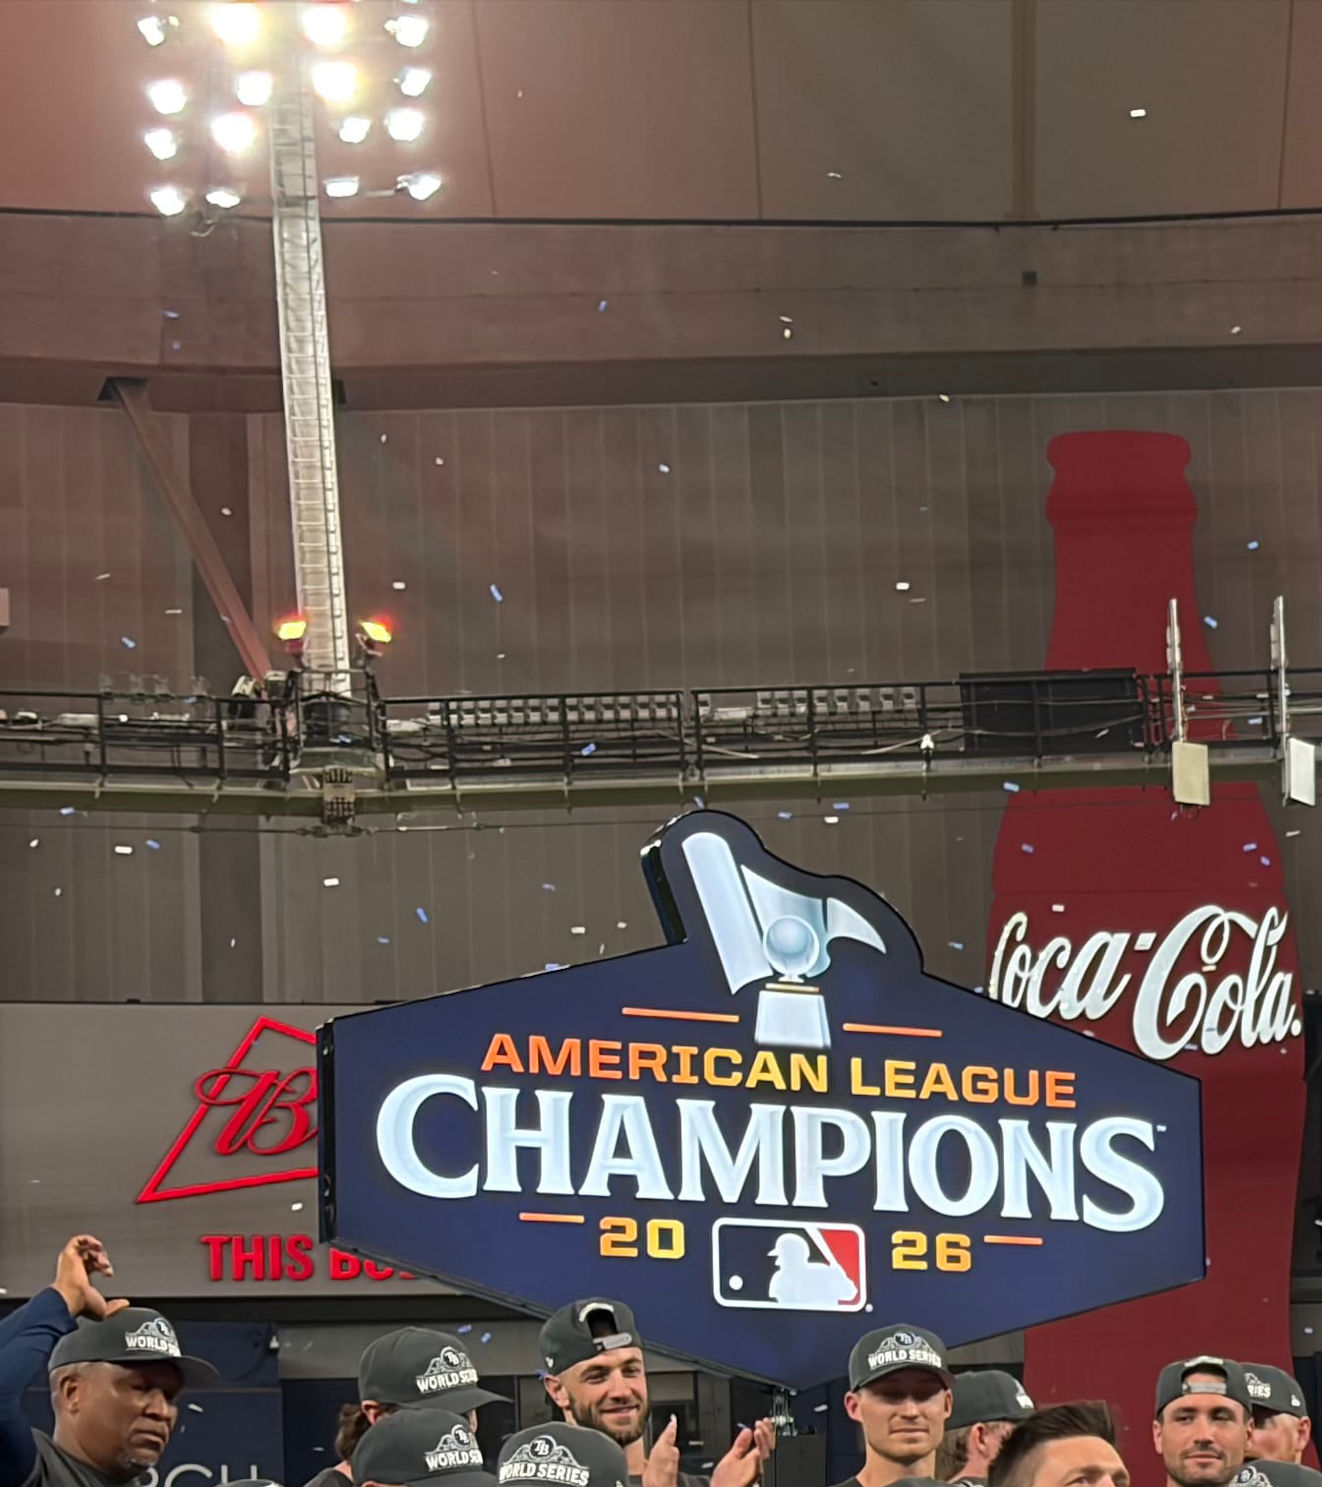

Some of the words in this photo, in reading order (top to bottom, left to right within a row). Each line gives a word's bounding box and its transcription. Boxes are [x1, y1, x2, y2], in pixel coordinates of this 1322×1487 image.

[481, 1033, 828, 1093] AMERICAN
[850, 1056, 1076, 1108] LEAGUE
[376, 1072, 1165, 1232] CHAMPIONS
[599, 1216, 685, 1259] 20
[891, 1230, 971, 1272] 26
[201, 1234, 314, 1282] THIS
[868, 1350, 908, 1370] WORLD
[416, 1373, 460, 1393] WORLD
[1246, 1384, 1272, 1399] RIES
[425, 1452, 466, 1471] WORLD
[538, 1463, 590, 1487] SERIES
